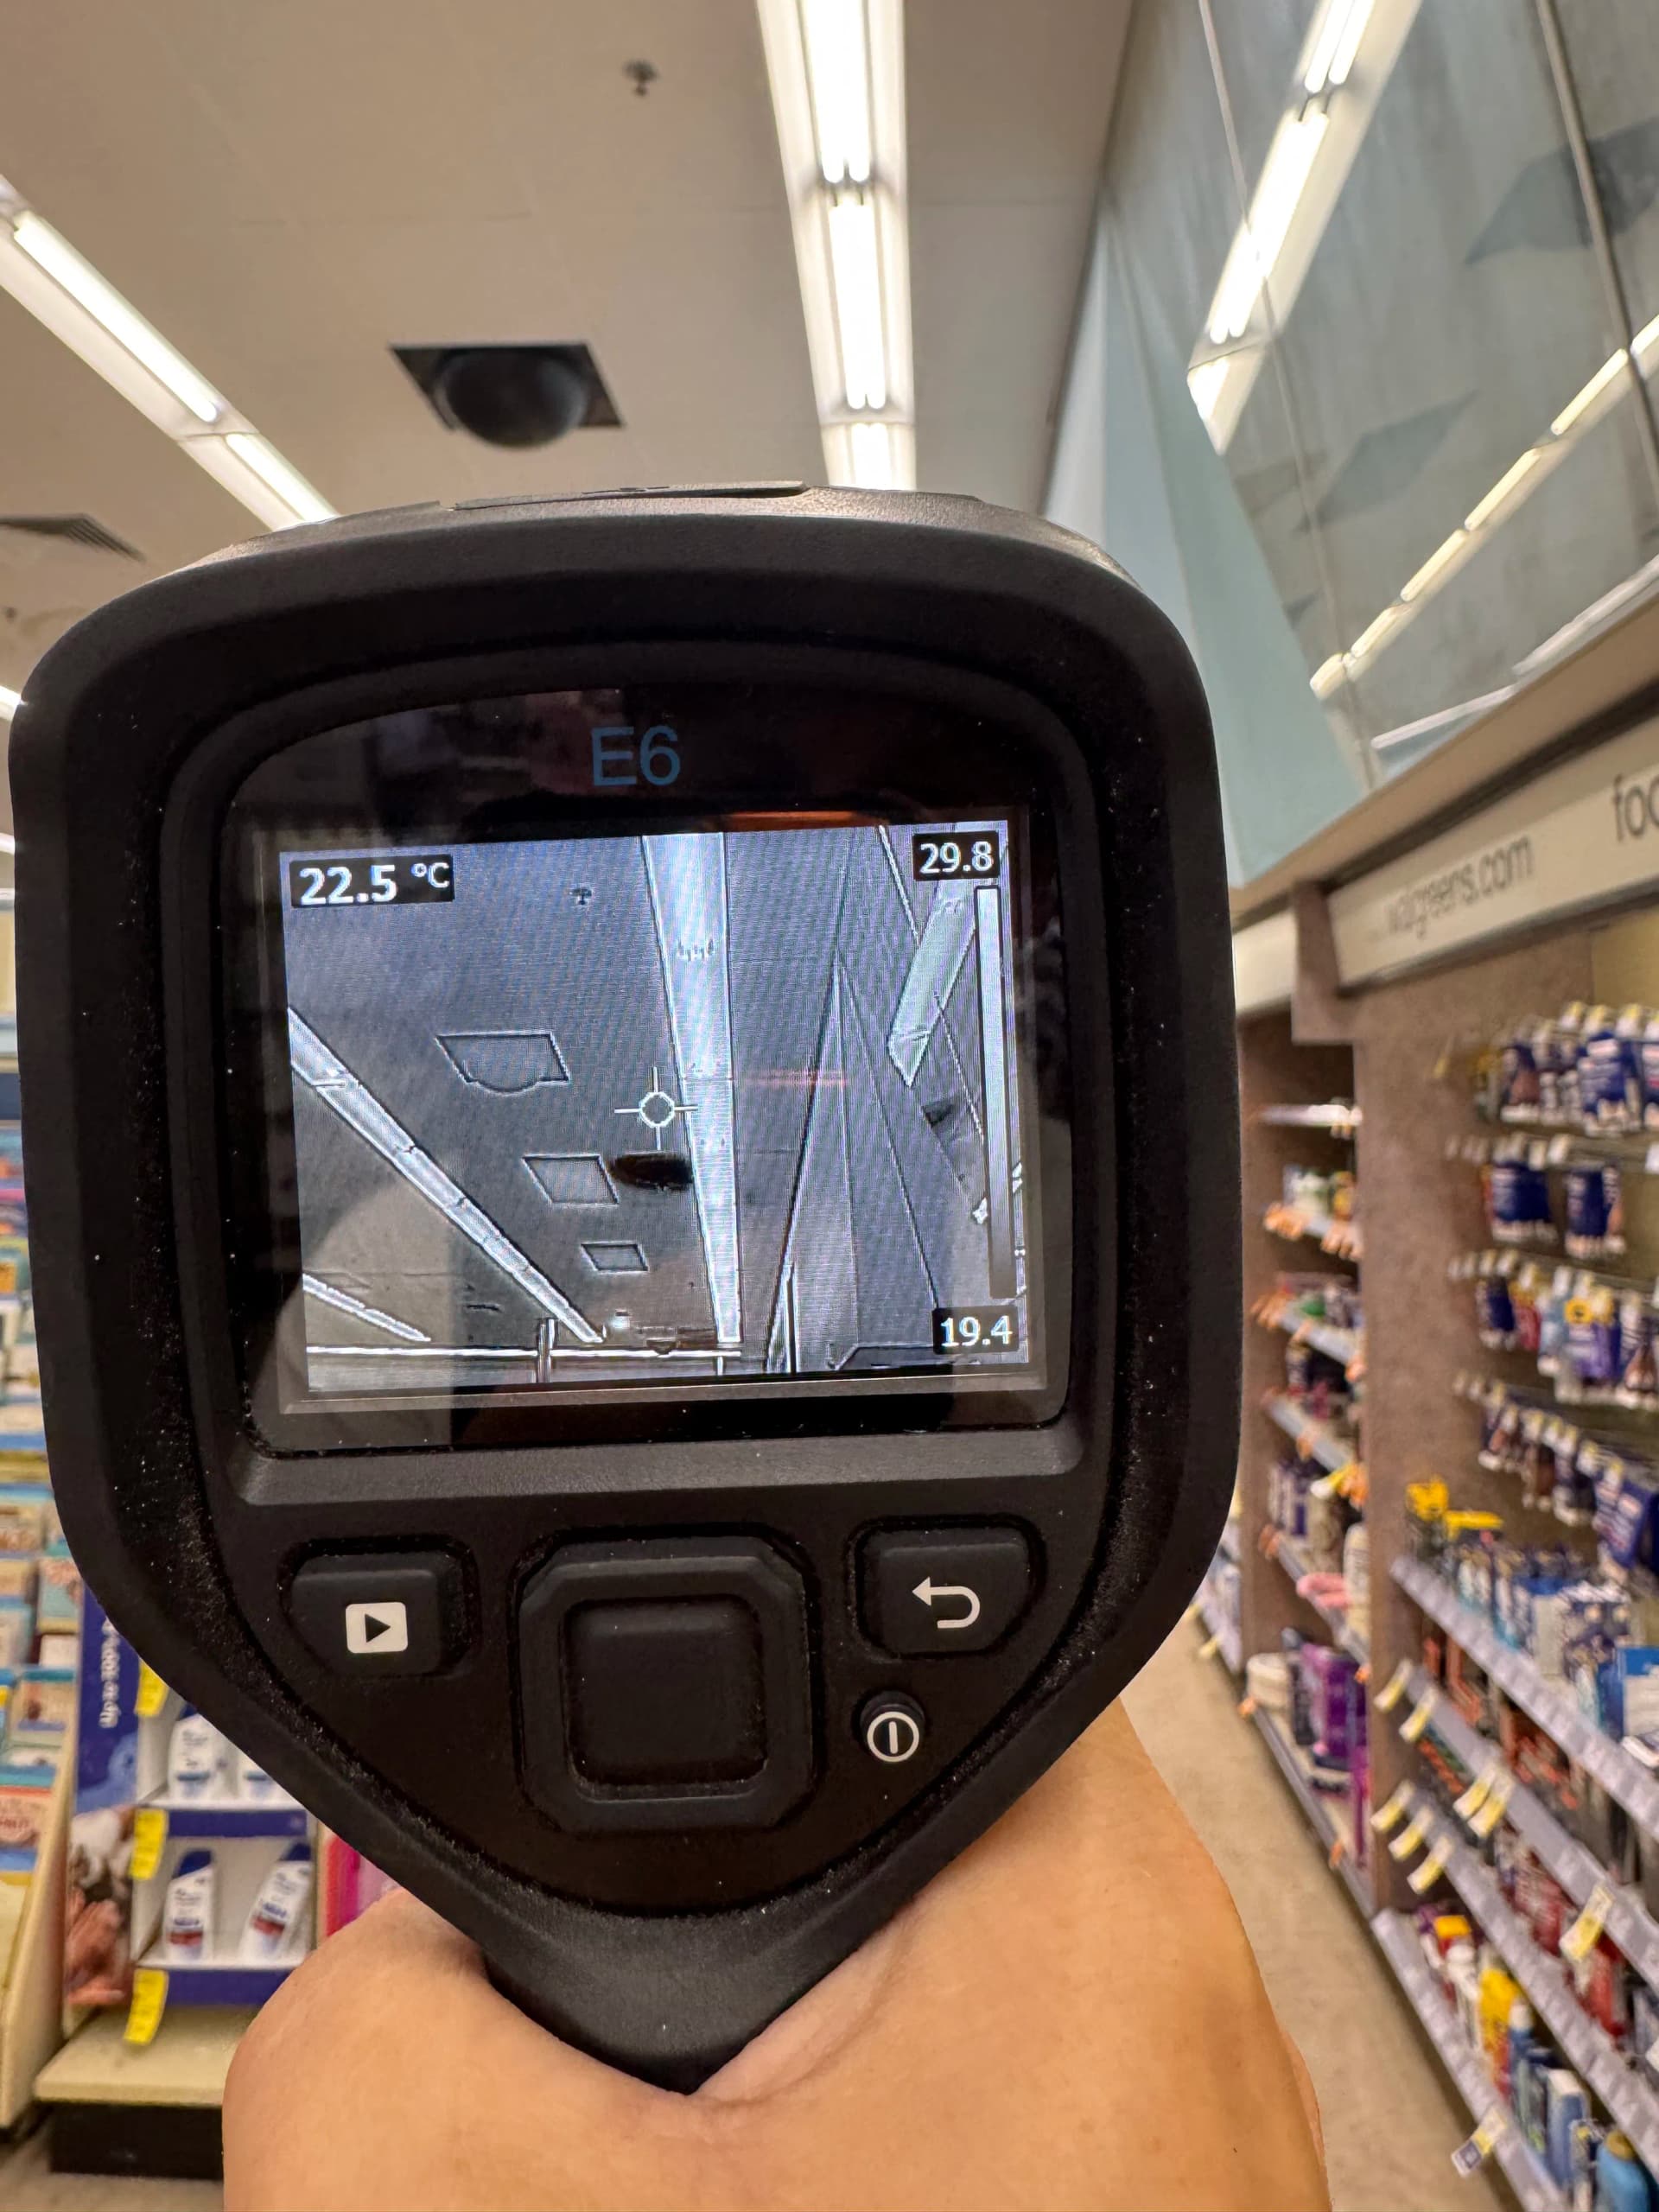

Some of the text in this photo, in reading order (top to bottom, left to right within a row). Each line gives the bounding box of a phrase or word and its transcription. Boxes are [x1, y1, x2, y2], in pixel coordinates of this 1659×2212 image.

[591, 725, 681, 786] E6
[919, 841, 994, 874] 29.8
[299, 864, 397, 906] 22.5
[940, 1315, 1013, 1346] 19.4
